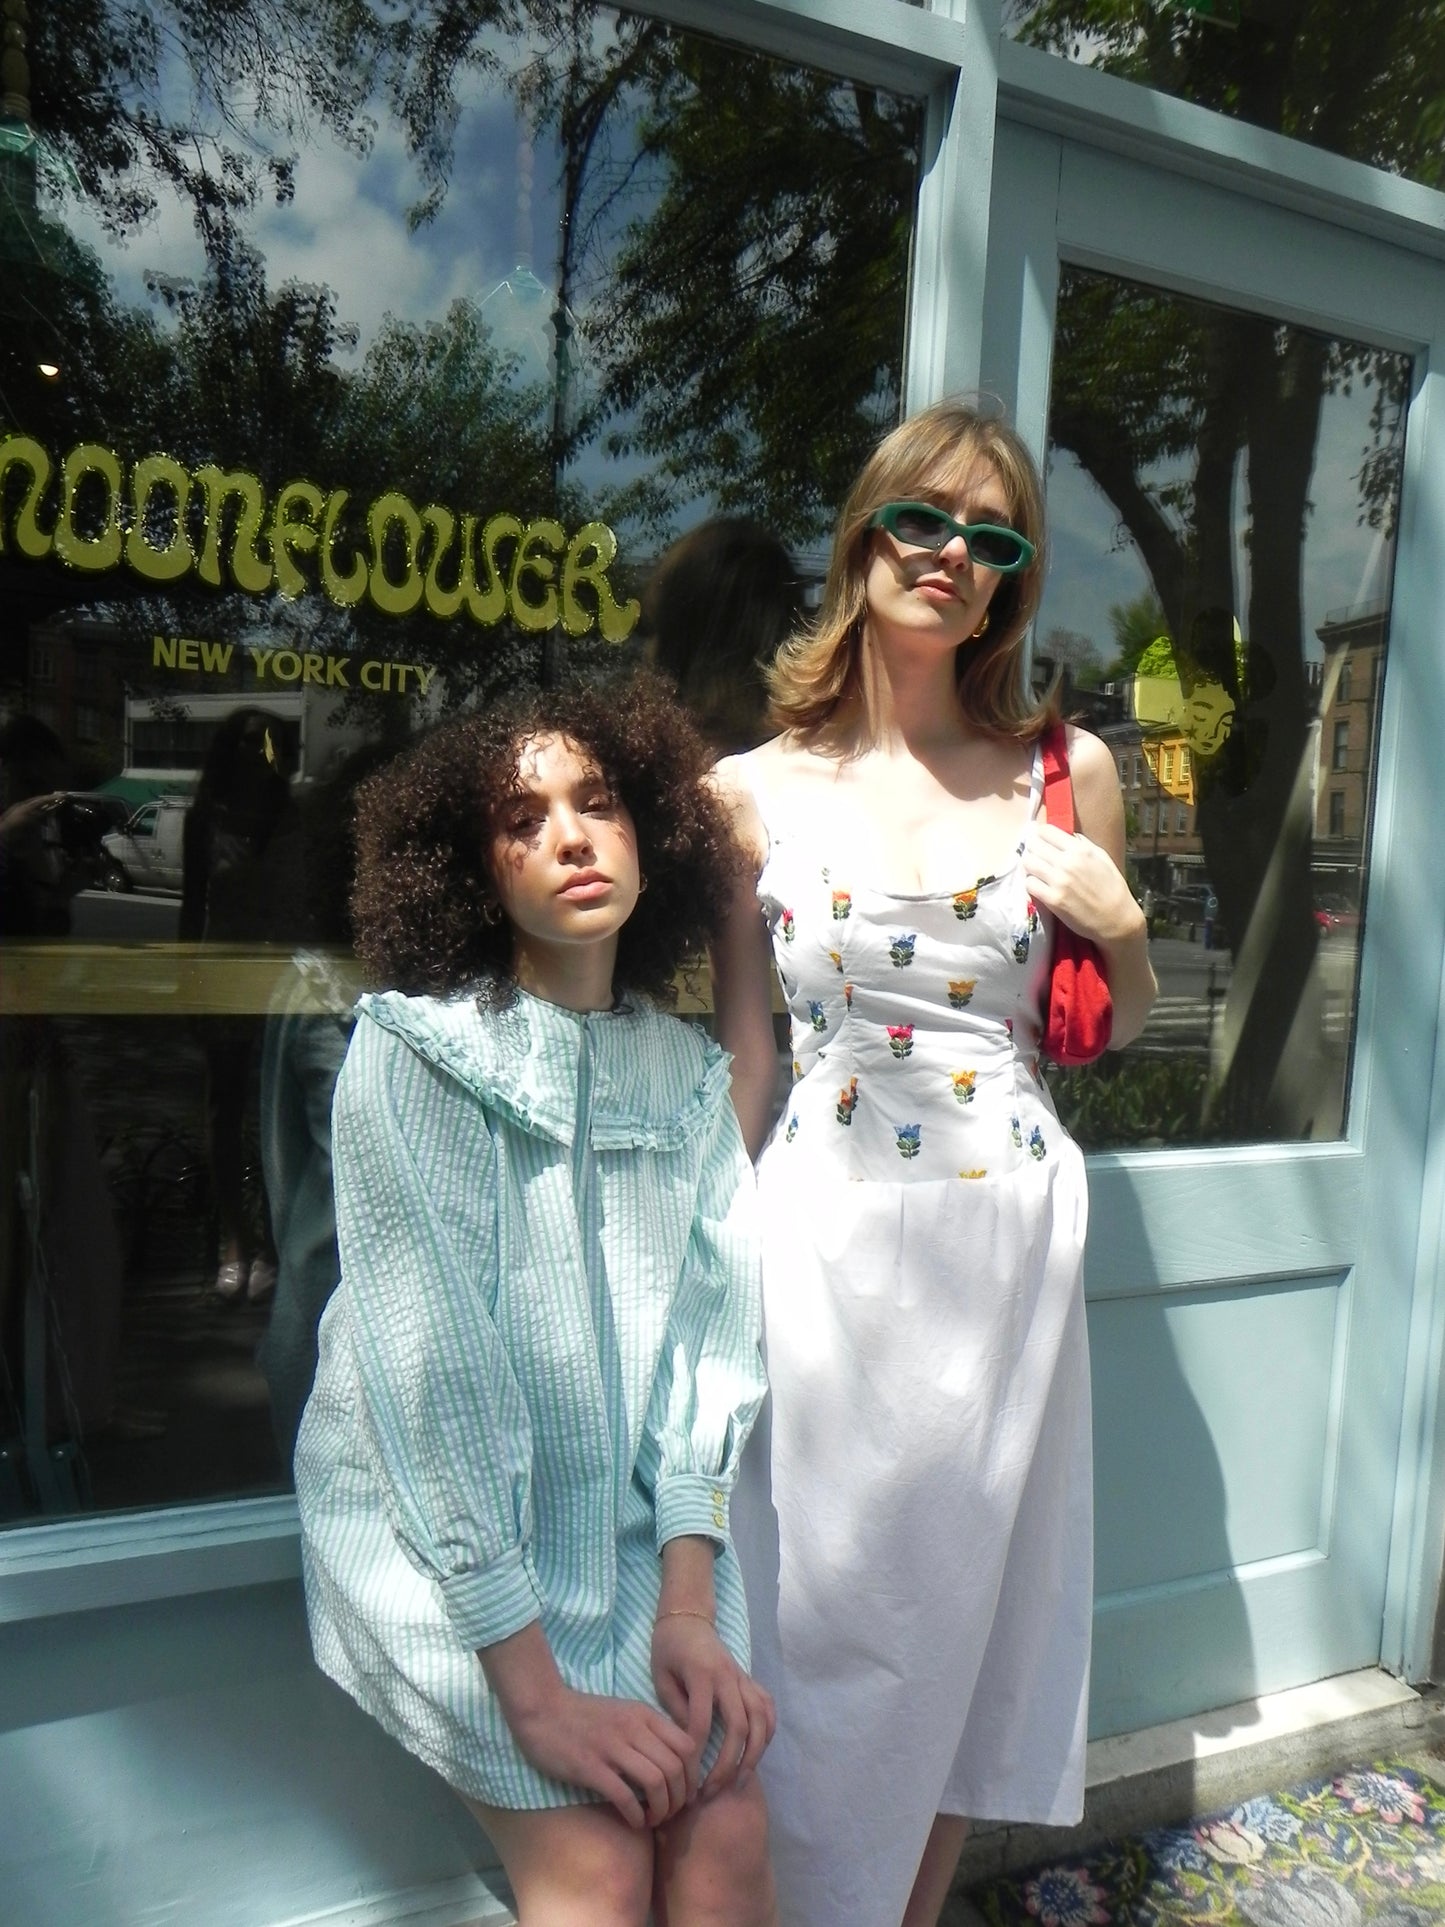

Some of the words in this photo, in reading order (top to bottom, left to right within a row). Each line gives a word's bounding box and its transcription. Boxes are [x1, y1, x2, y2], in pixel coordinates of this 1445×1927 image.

[153, 636, 233, 673] NEW
[249, 647, 350, 687] YORK
[360, 661, 436, 695] CITY
